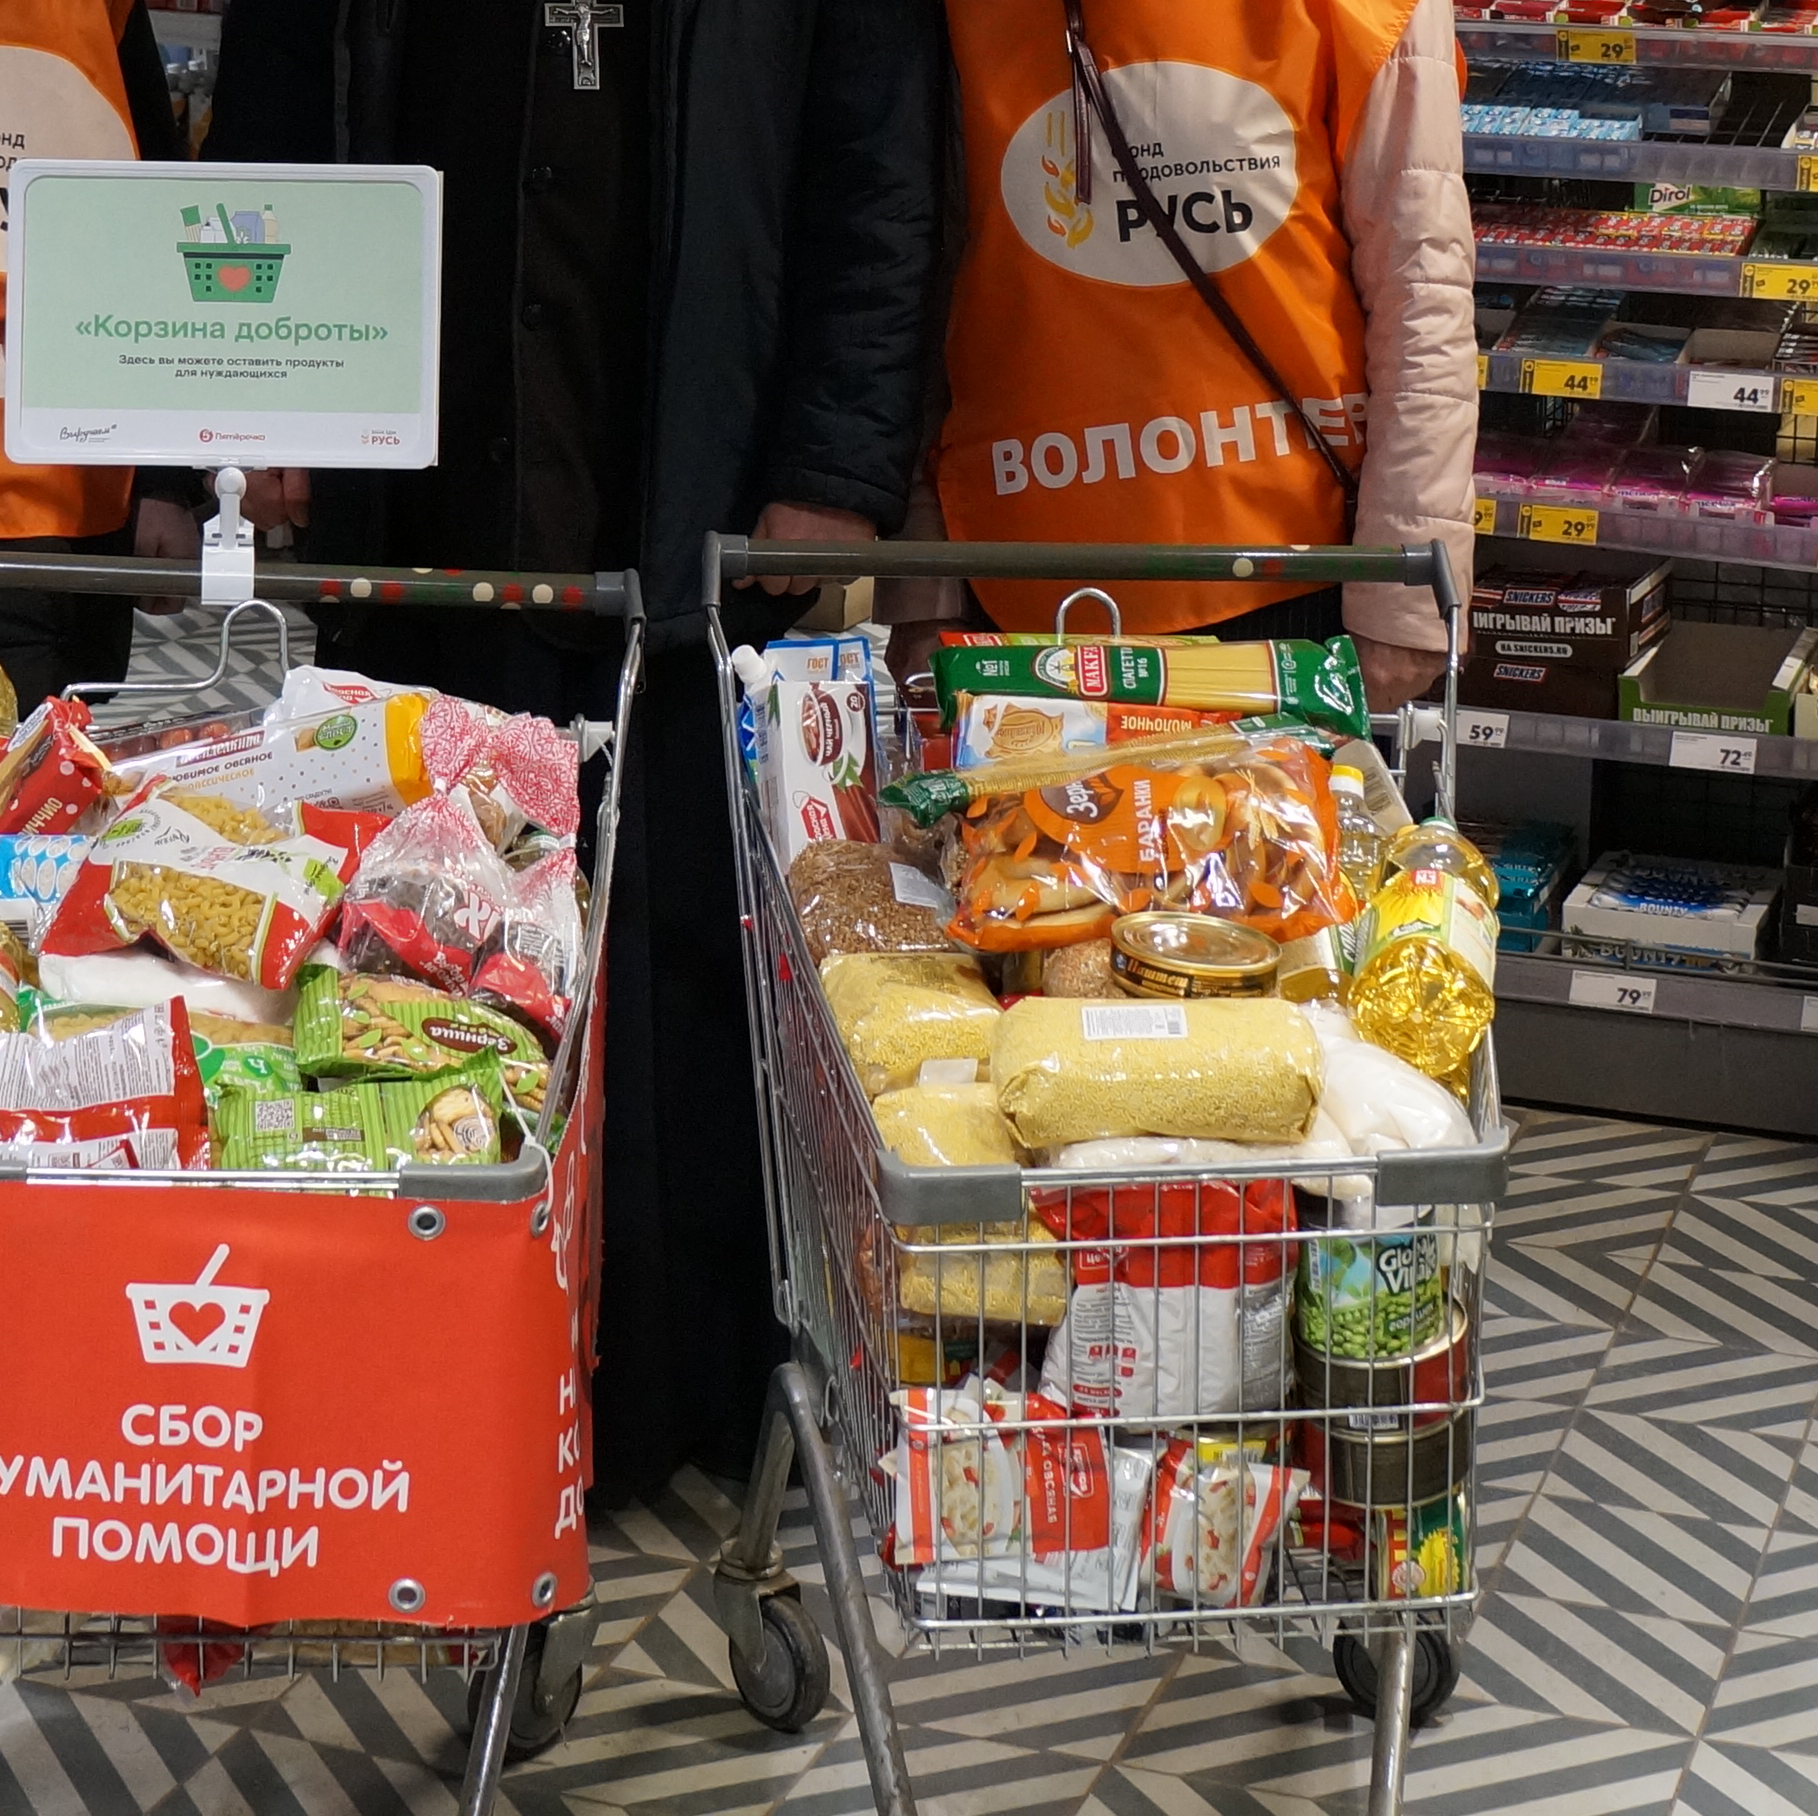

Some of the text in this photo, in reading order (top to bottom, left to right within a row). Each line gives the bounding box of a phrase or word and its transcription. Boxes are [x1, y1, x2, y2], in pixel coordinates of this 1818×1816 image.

[1600, 42, 1624, 59] 29
[1649, 185, 1691, 207] Dirol
[1787, 278, 1811, 295] 29
[75, 314, 389, 346] «Корзина доброты»
[118, 354, 345, 371] Здесь вы можете оставить продукты
[174, 368, 288, 381] для нуждающихся
[1563, 374, 1590, 392] 44
[1733, 387, 1759, 405] 44
[371, 436, 401, 447] РУСЬ
[1562, 520, 1586, 537] 29
[1504, 588, 1555, 606] SNICKERS
[1513, 642, 1569, 658] SNICKERS.RU
[807, 656, 830, 670] ГОСТ
[1494, 665, 1546, 681] SNICKERS
[1632, 707, 1771, 734] ВЫИГРЫВАЙ ПРИЗЫ
[1468, 723, 1494, 741] 59
[1719, 748, 1742, 766] 72
[1135, 778, 1156, 863] БАРАНКИ
[1639, 902, 1688, 918] BOUNTY
[1616, 988, 1642, 1005] 79
[120, 1403, 264, 1452] СБОР
[51, 1517, 321, 1577] ПОМОЩИ
